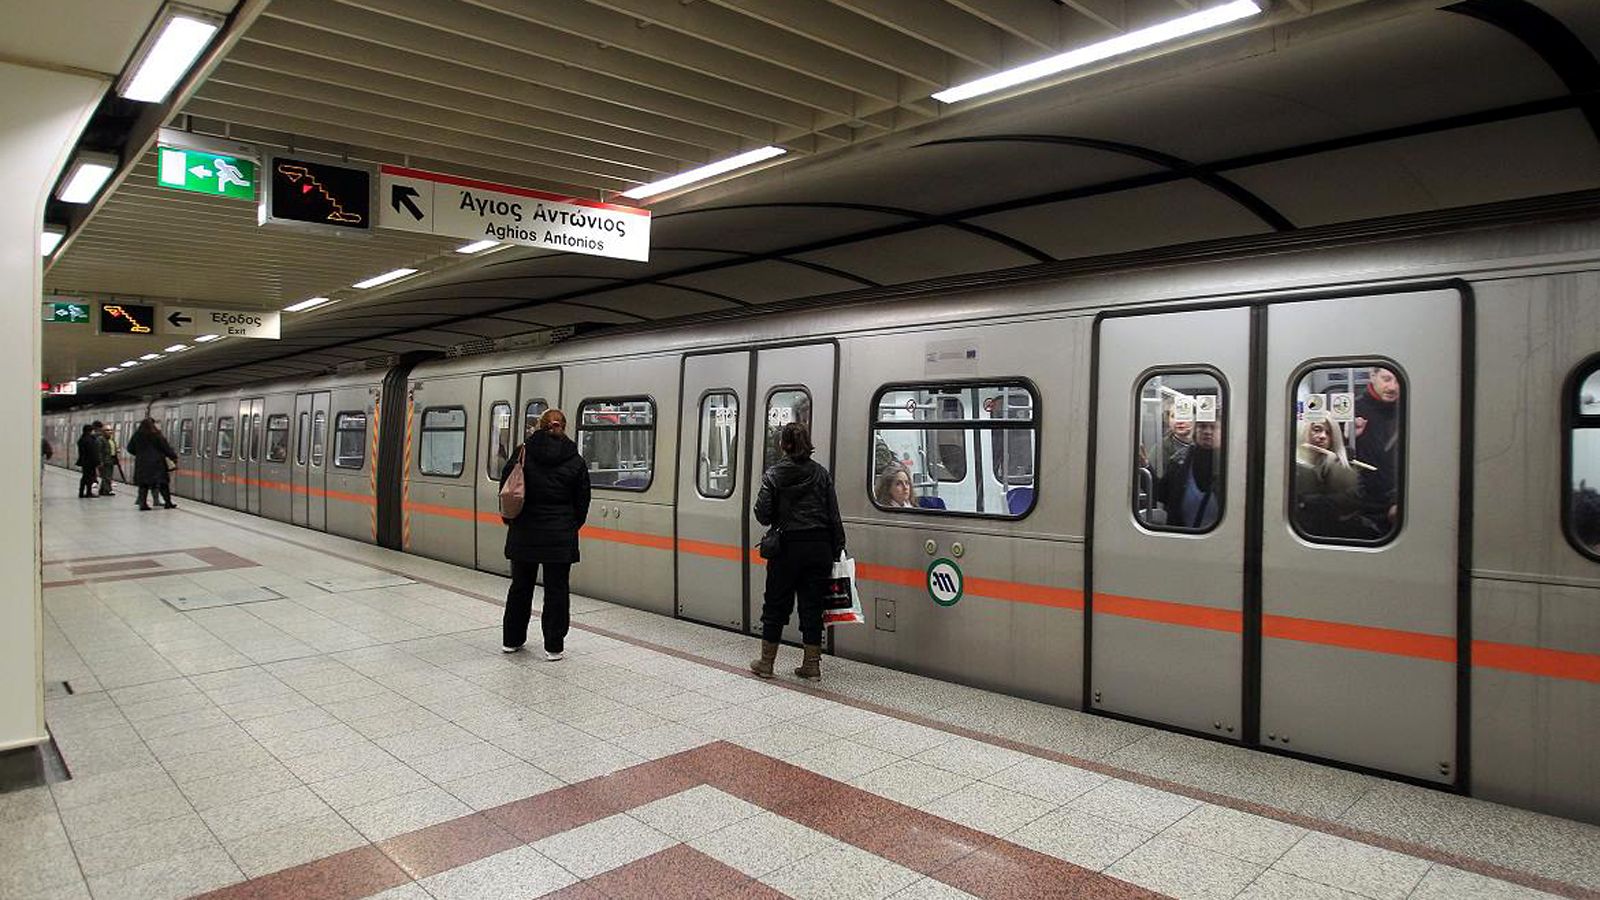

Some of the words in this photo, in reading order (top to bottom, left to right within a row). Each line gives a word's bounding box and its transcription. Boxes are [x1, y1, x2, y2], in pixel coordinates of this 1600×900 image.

[460, 191, 522, 222] Άγιος
[533, 203, 626, 237] Αντώνιος
[485, 222, 537, 241] Aghios
[543, 230, 604, 251] Antonios
[210, 312, 262, 327] Έξοδος
[228, 327, 246, 335] Exit
